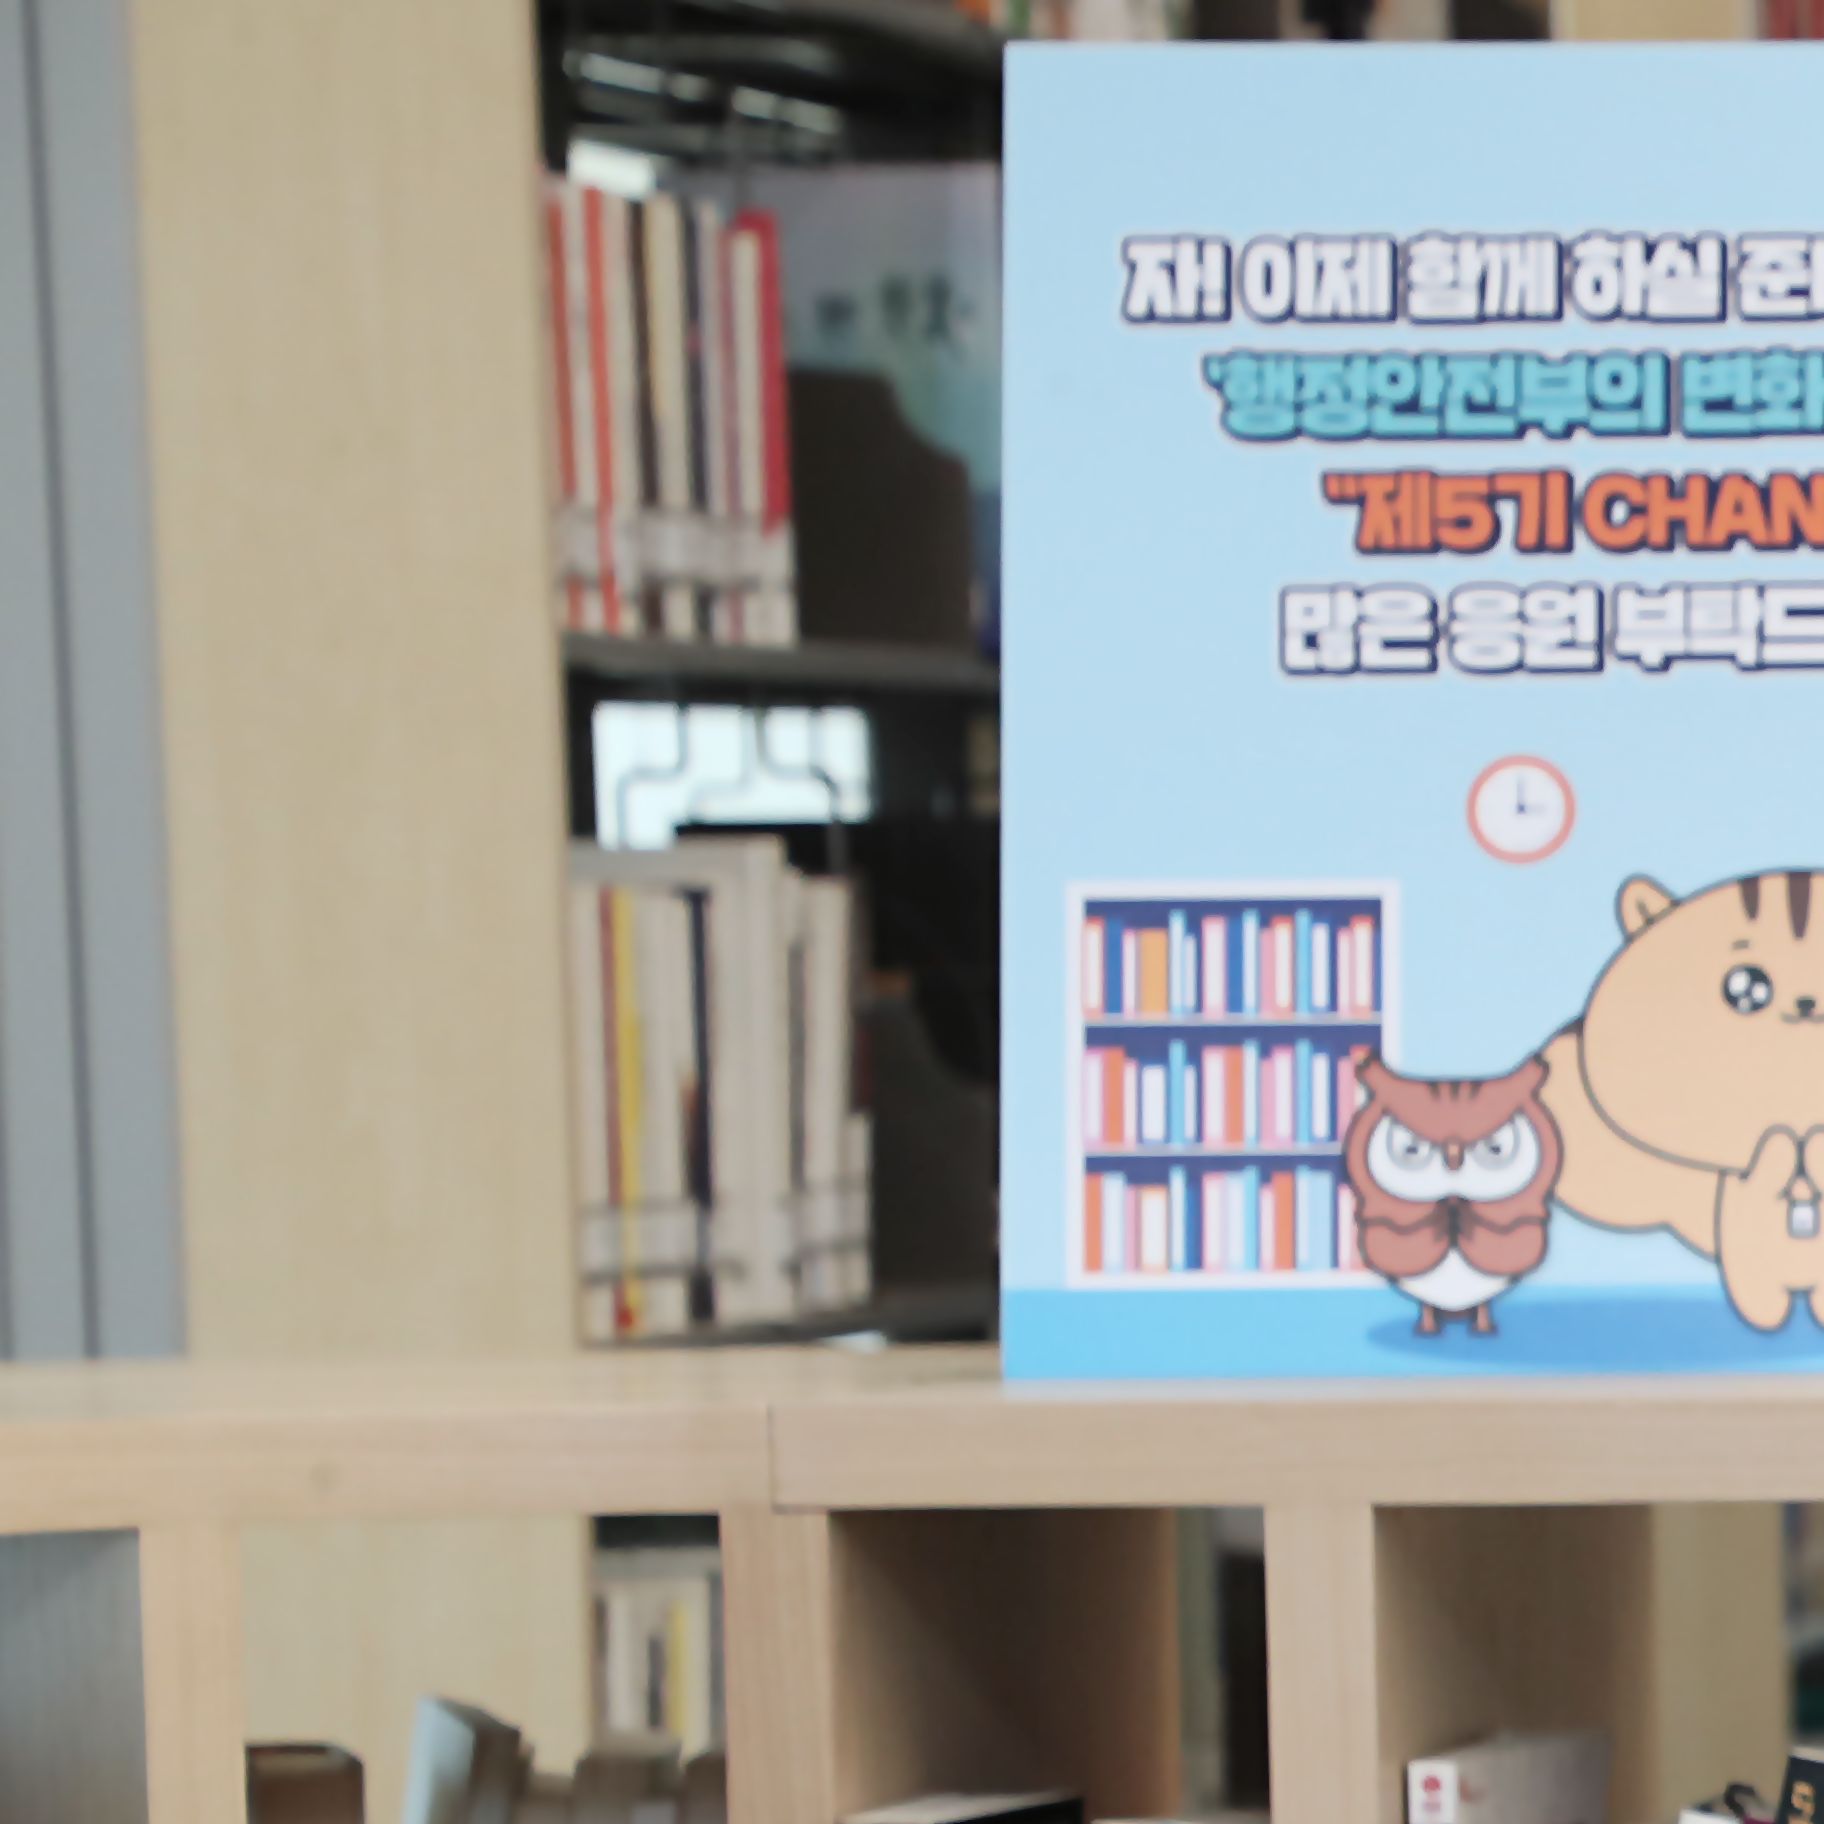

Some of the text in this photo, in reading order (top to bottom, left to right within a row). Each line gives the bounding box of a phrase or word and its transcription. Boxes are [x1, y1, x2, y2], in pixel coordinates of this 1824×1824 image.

[1122, 235, 1232, 323] 자!
[1241, 234, 1398, 322] 이제
[1405, 231, 1563, 324] 함께
[1569, 231, 1727, 323] 하실
[1320, 468, 1574, 556] "제5기
[1279, 578, 1438, 674] 많은
[1447, 578, 1602, 674] 응원
